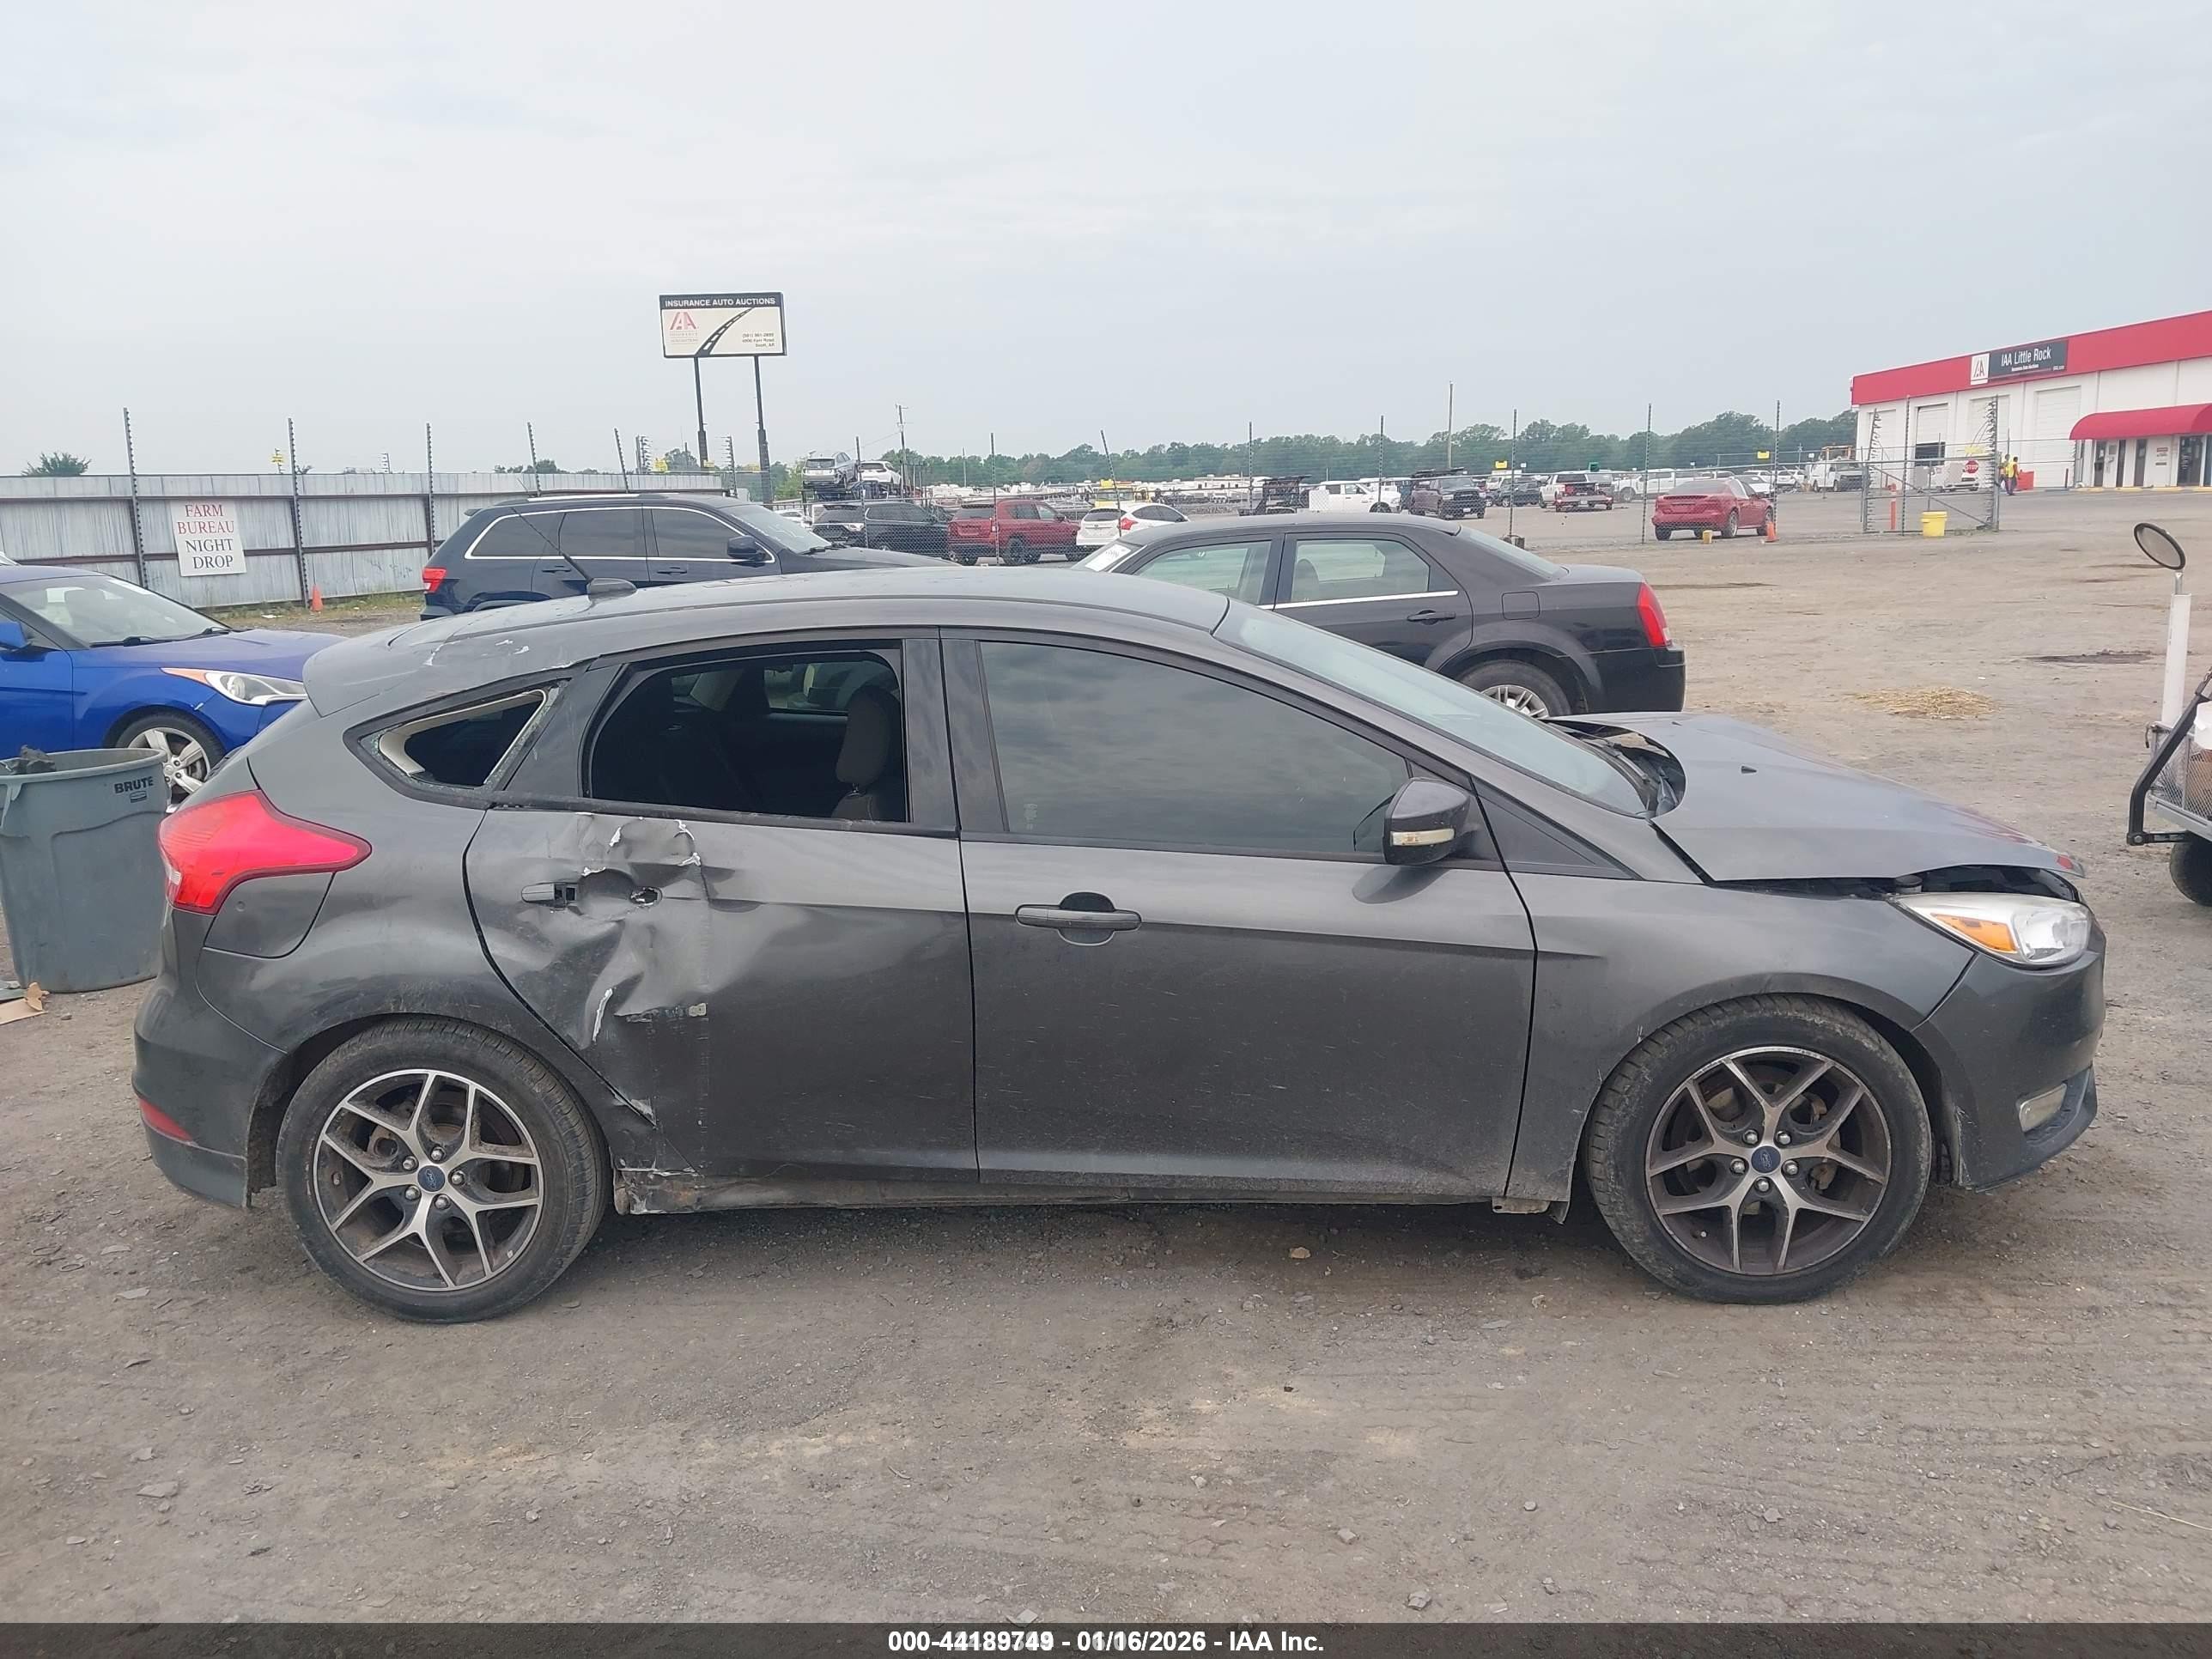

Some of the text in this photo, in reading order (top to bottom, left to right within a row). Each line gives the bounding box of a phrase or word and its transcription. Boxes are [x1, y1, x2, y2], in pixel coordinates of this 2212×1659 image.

[665, 297, 776, 307] INSURANCE AUTO AUCTIONS
[2001, 346, 2052, 367] IAA Little Rock
[185, 504, 223, 517] FARM
[177, 520, 234, 534] BUREAU
[185, 538, 233, 552] NIGHT
[192, 555, 234, 568] DROP
[114, 776, 154, 793] BRUTE
